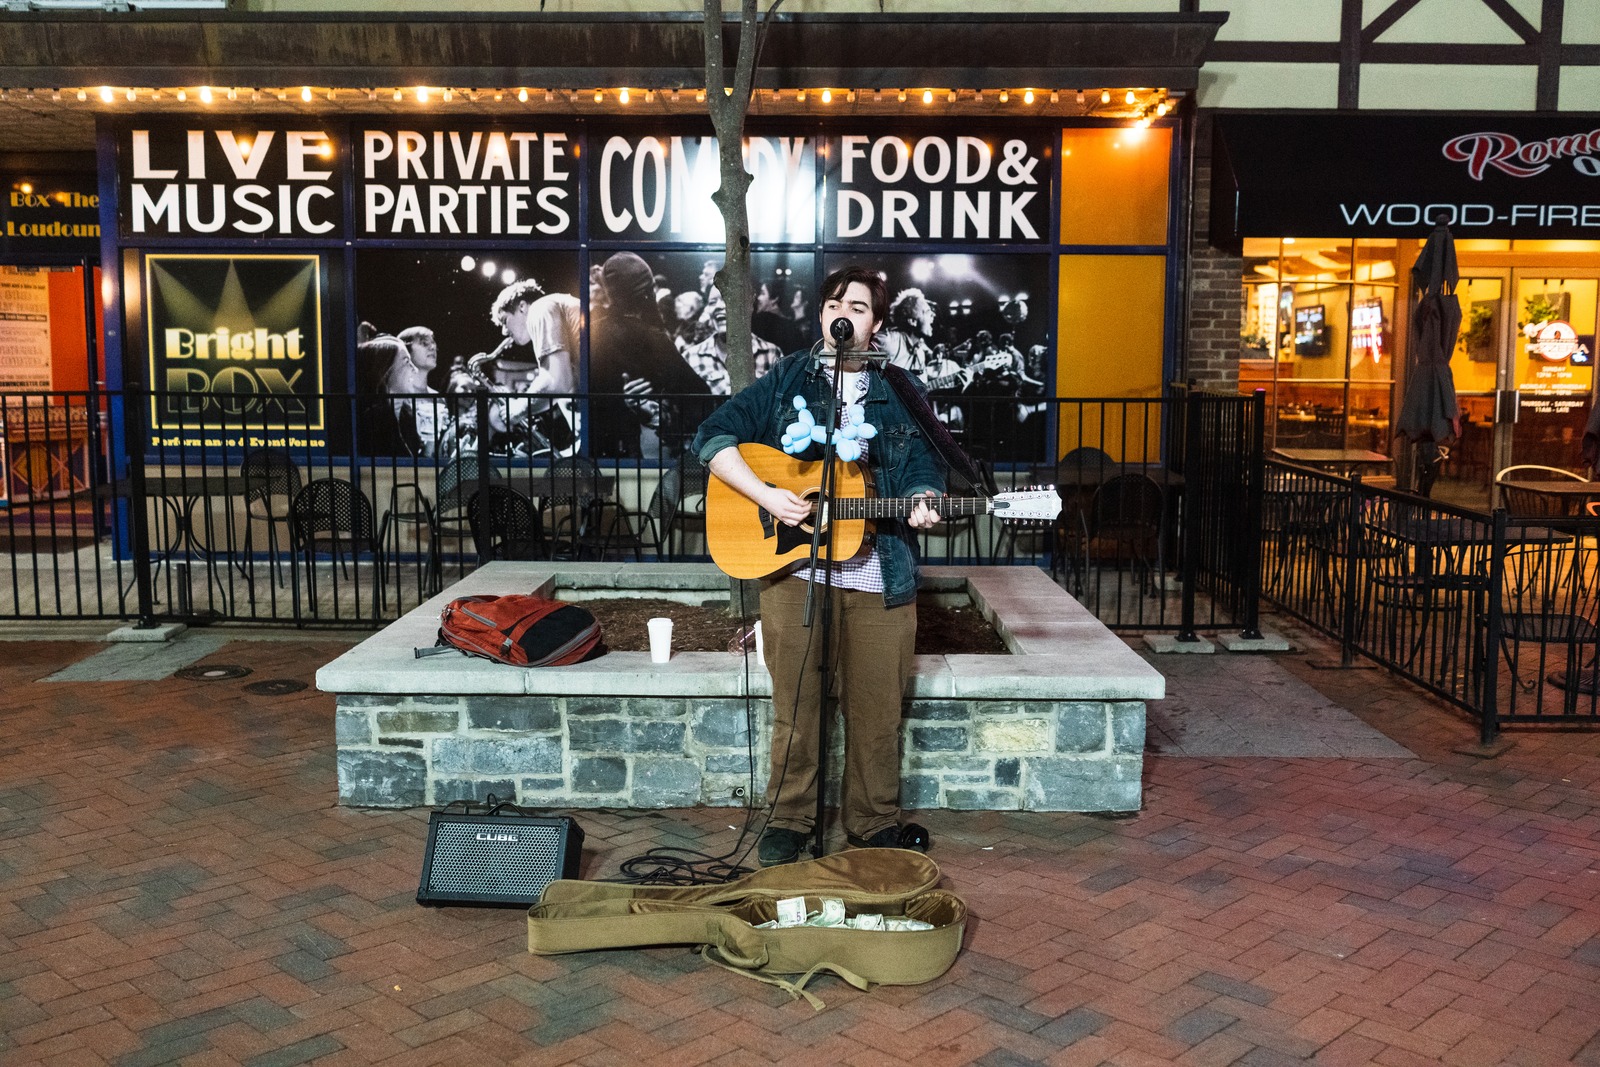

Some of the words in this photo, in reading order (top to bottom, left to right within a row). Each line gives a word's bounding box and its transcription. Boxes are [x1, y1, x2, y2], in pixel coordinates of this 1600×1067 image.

[132, 130, 333, 180] LIVE
[364, 131, 569, 181] PRIVATE
[10, 191, 50, 207] Box
[131, 183, 335, 234] MUSIC
[365, 184, 570, 234] PARTIES
[600, 136, 806, 233] COMDY
[7, 221, 100, 237] Loudoun
[837, 190, 1040, 239] DRINK
[165, 327, 305, 361] Bright
[166, 366, 305, 415] BOX
[476, 832, 519, 842] CUBE
